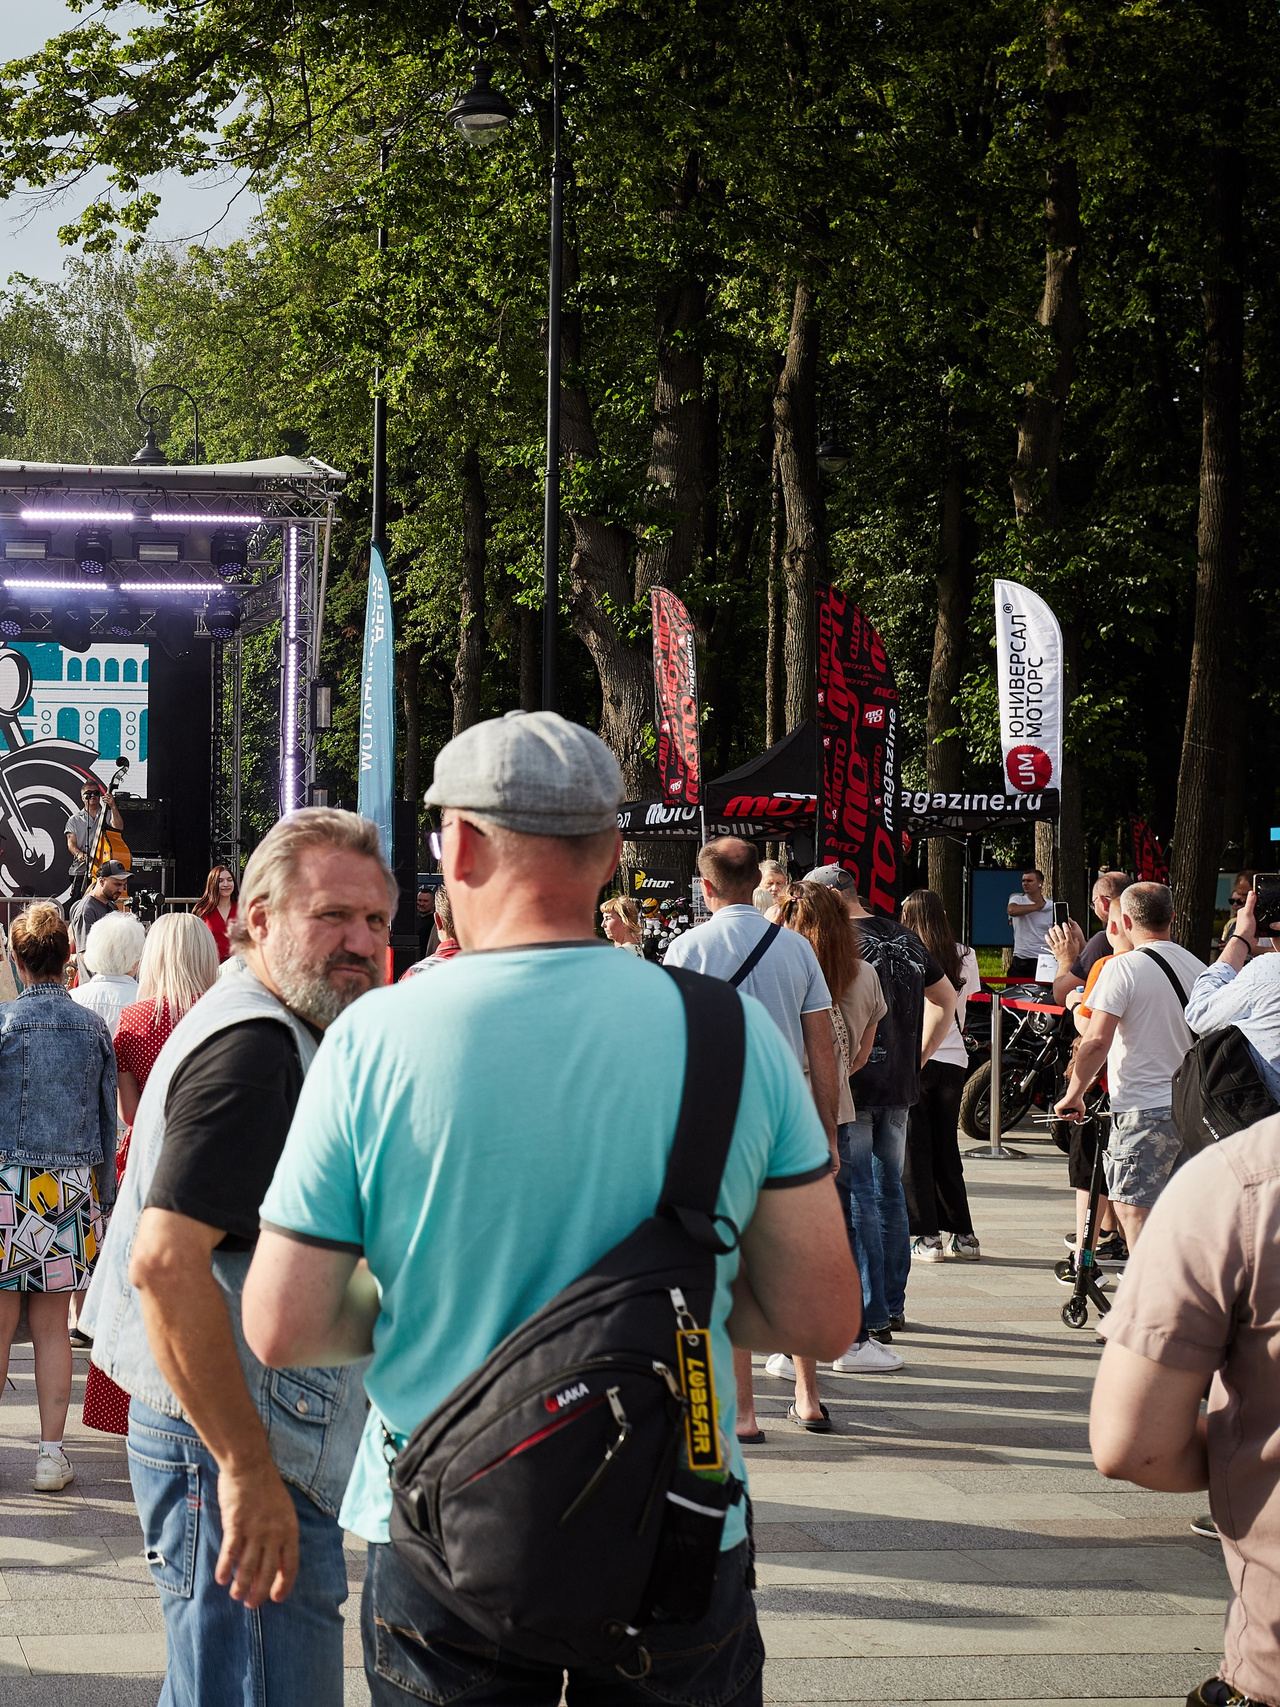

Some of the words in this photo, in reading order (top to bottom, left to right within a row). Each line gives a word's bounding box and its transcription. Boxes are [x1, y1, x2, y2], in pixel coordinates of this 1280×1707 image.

[686, 633, 695, 697] magazine
[1009, 614, 1027, 738] ЮНИВЕРСАЛ
[1026, 656, 1044, 738] МОТОРС
[883, 708, 896, 832] magazine
[1016, 753, 1036, 786] UM
[901, 791, 1043, 814] agazine.ru
[642, 878, 674, 888] thor
